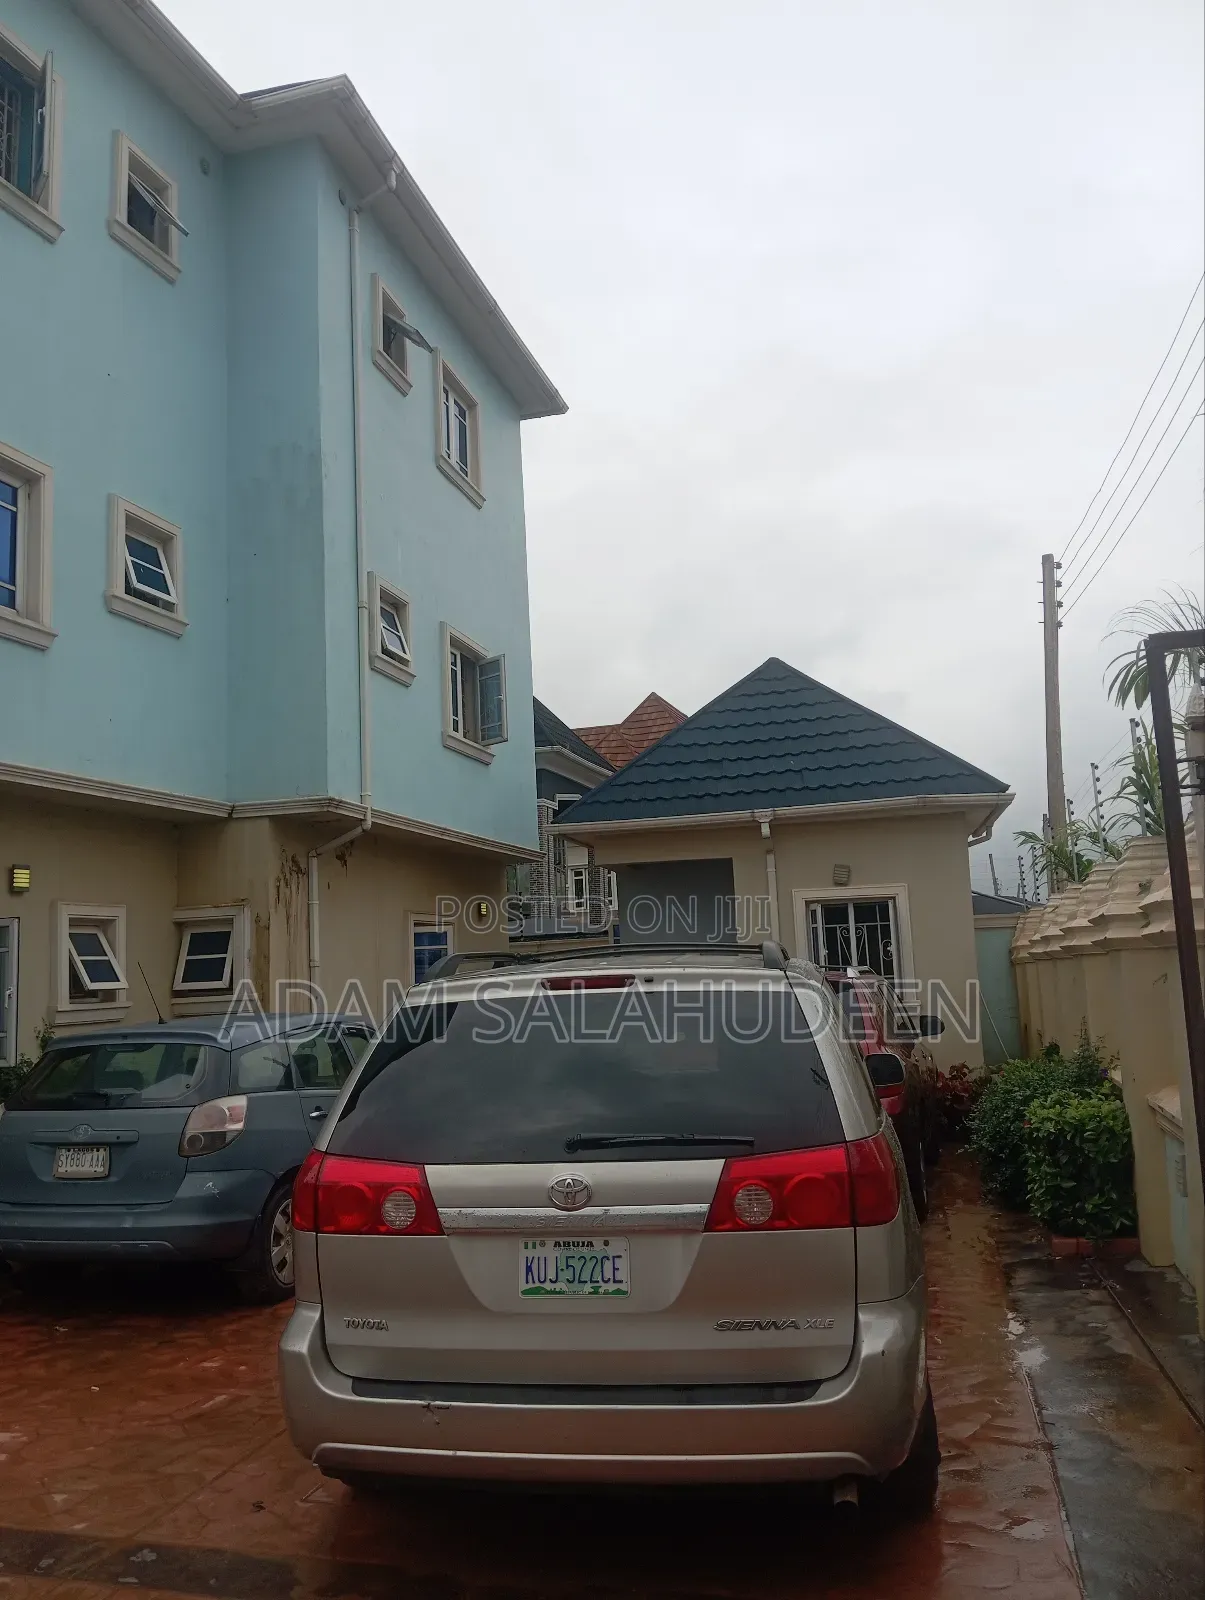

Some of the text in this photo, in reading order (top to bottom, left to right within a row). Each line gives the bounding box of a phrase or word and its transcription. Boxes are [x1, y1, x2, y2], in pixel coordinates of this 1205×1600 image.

[552, 1240, 595, 1248] ABUJA
[525, 1255, 624, 1285] KUJ-522CE
[343, 1317, 390, 1332] TOYOTA
[713, 1318, 835, 1332] SIENNA XLE
